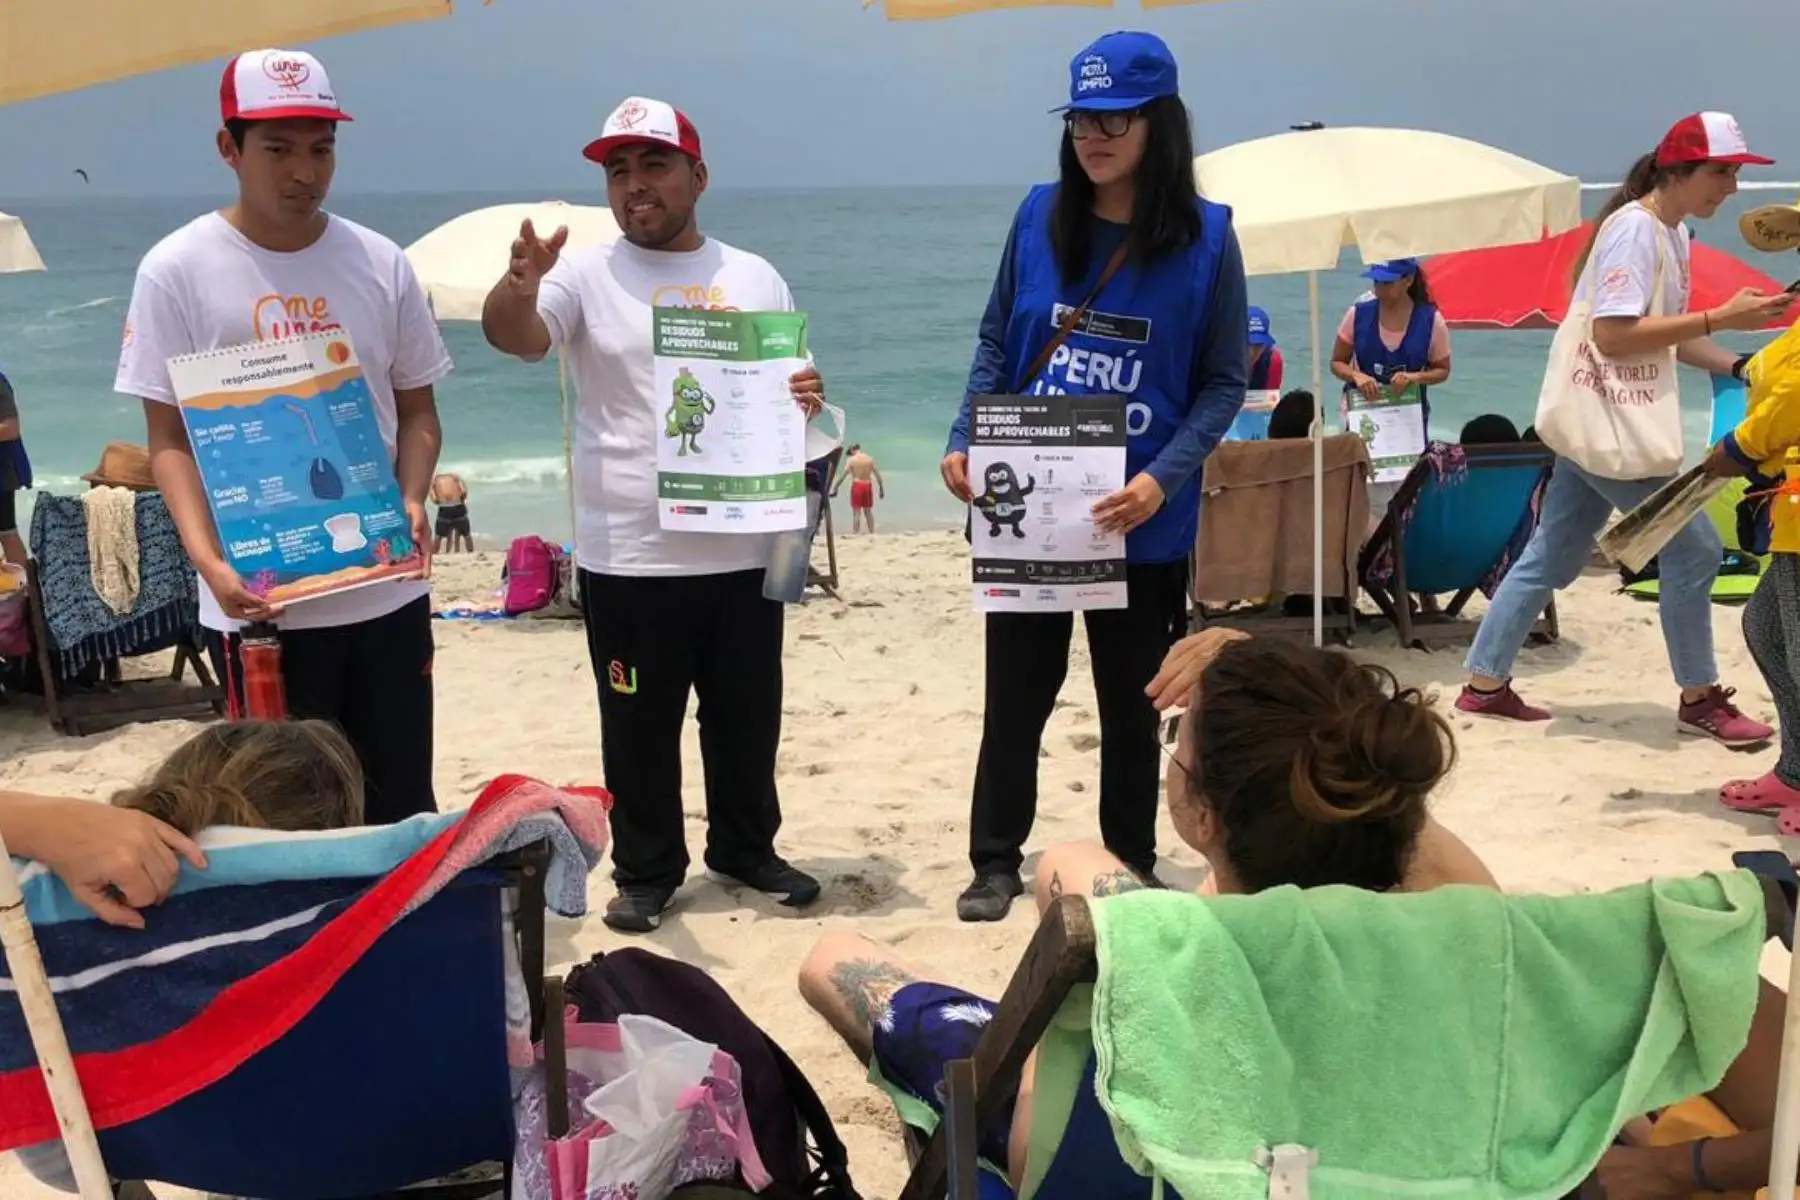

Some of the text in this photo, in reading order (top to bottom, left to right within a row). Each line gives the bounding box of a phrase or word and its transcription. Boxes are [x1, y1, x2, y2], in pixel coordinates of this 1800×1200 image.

[660, 324, 706, 337] RESIDUOS
[660, 336, 739, 352] APROVECHABLES
[241, 354, 288, 369] Consume
[1048, 344, 1143, 393] PERÚ
[221, 362, 315, 386] responsablemente
[1609, 387, 1656, 405] AGAIN
[976, 414, 1021, 425] RESIDUOS
[976, 425, 990, 437] NO
[992, 425, 1071, 437] APROVECHABLES
